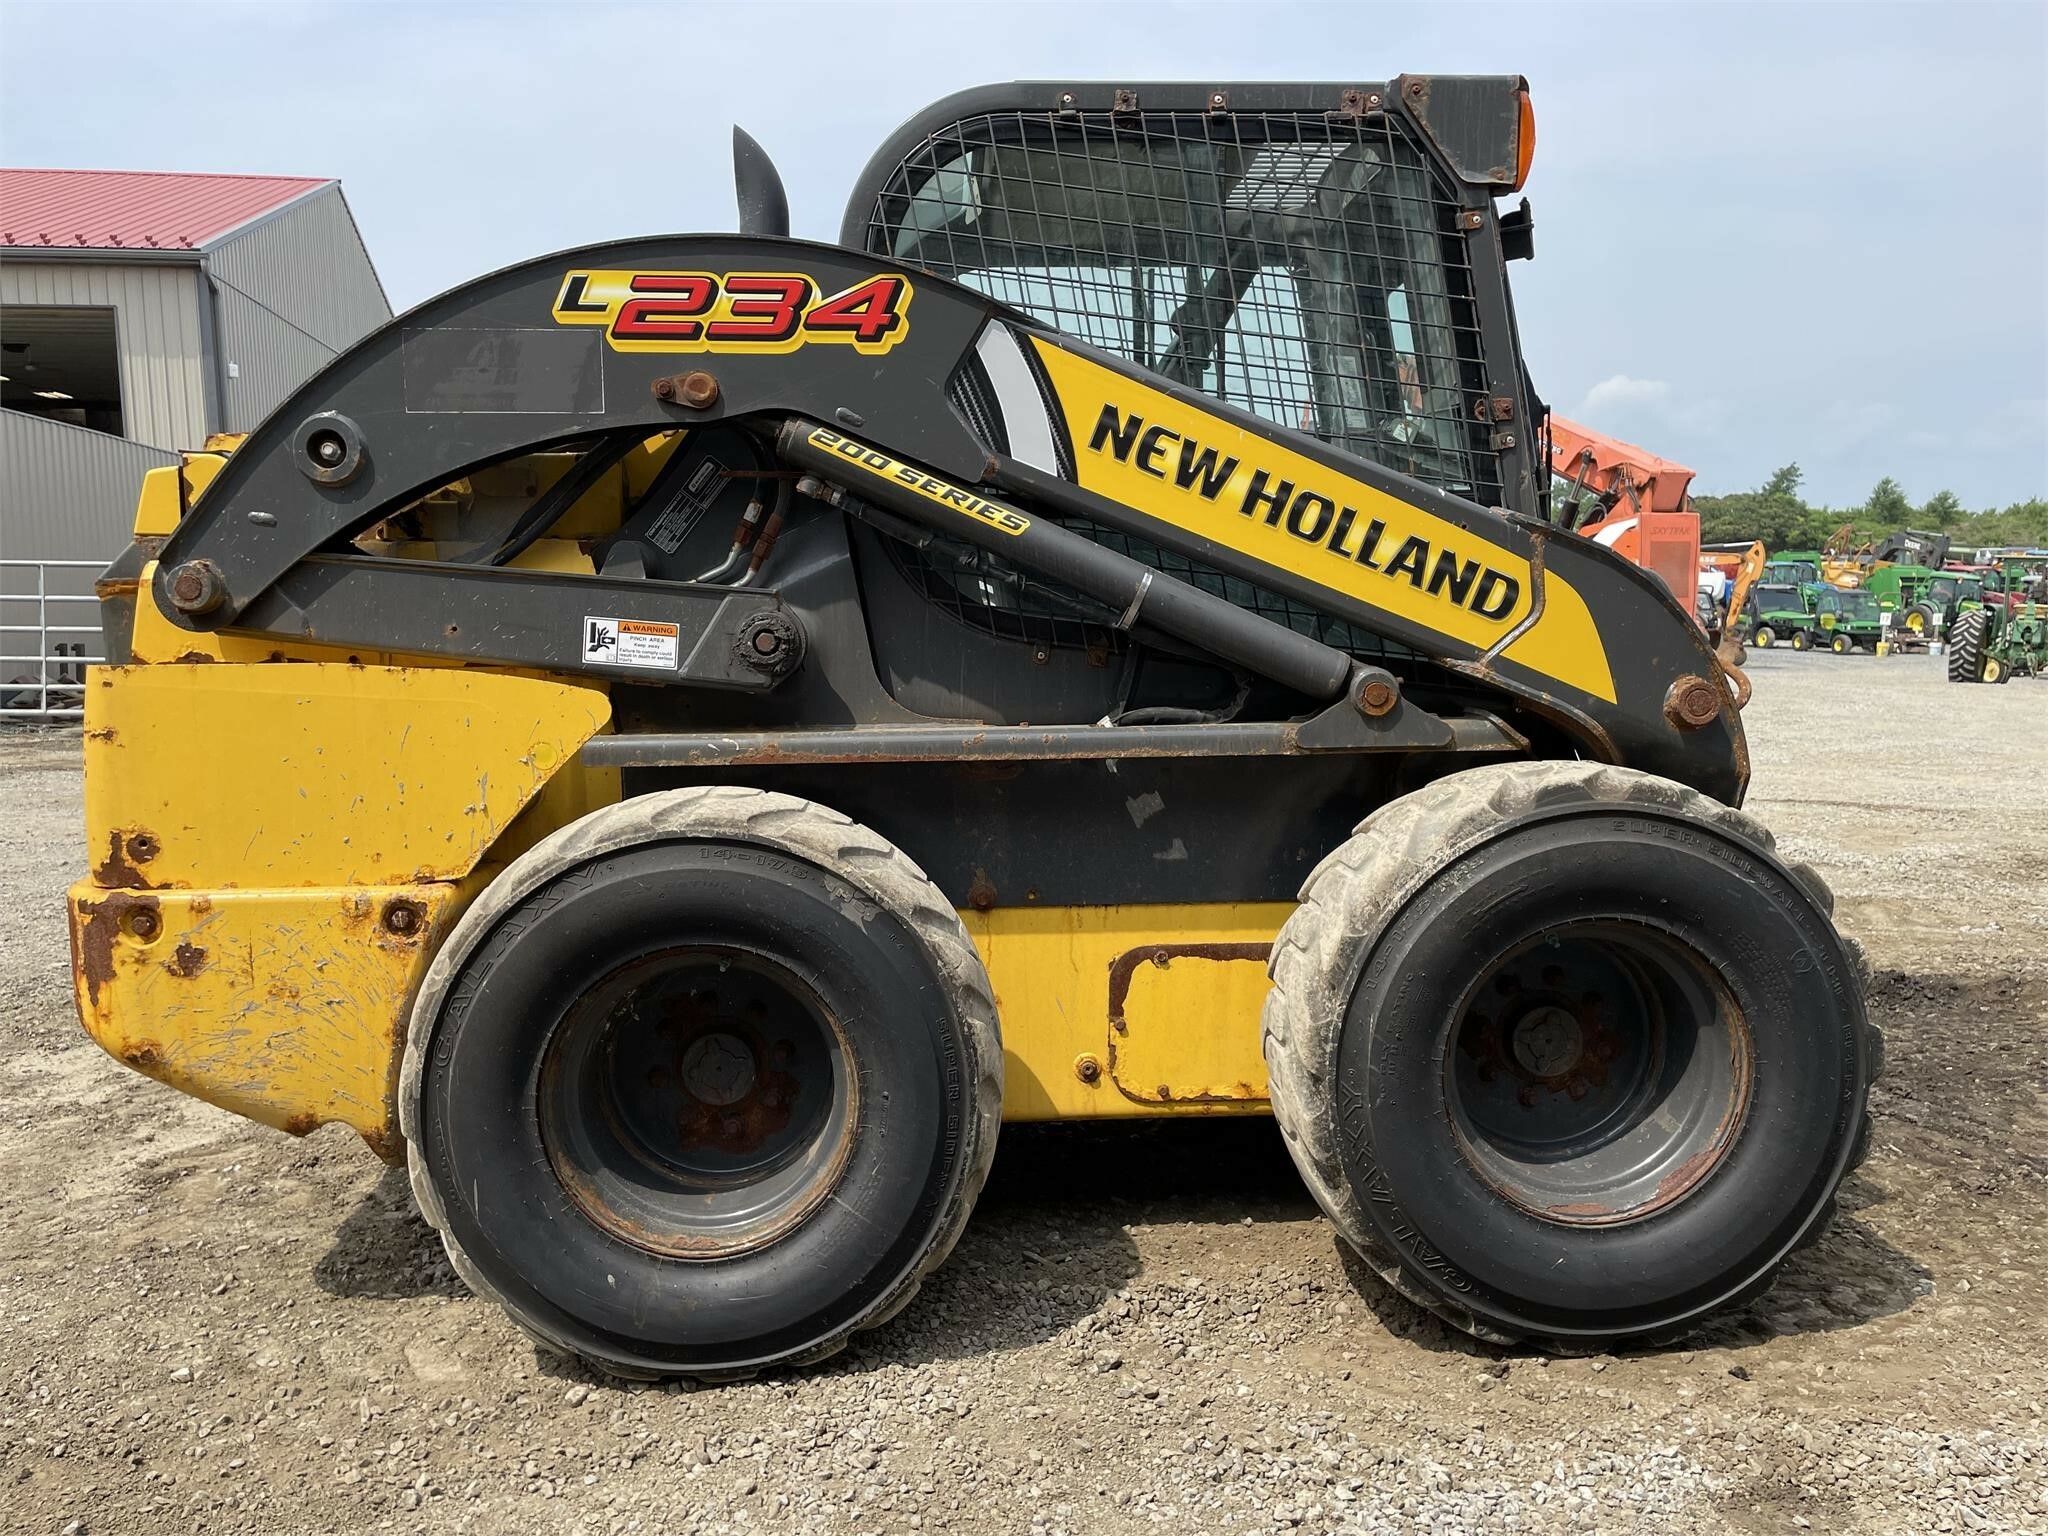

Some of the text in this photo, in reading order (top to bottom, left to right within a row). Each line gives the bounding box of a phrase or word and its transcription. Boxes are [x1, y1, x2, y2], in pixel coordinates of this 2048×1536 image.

[557, 273, 905, 342] L234
[812, 429, 1030, 531] 200 SERIES
[1088, 402, 1520, 622] NEW HOLLAND
[633, 625, 673, 634] WARNING
[1611, 819, 1698, 847] SUPER
[434, 863, 599, 1067] GALAXY
[935, 1016, 961, 1104] SUPER
[1340, 1080, 1473, 1293] GALAXY
